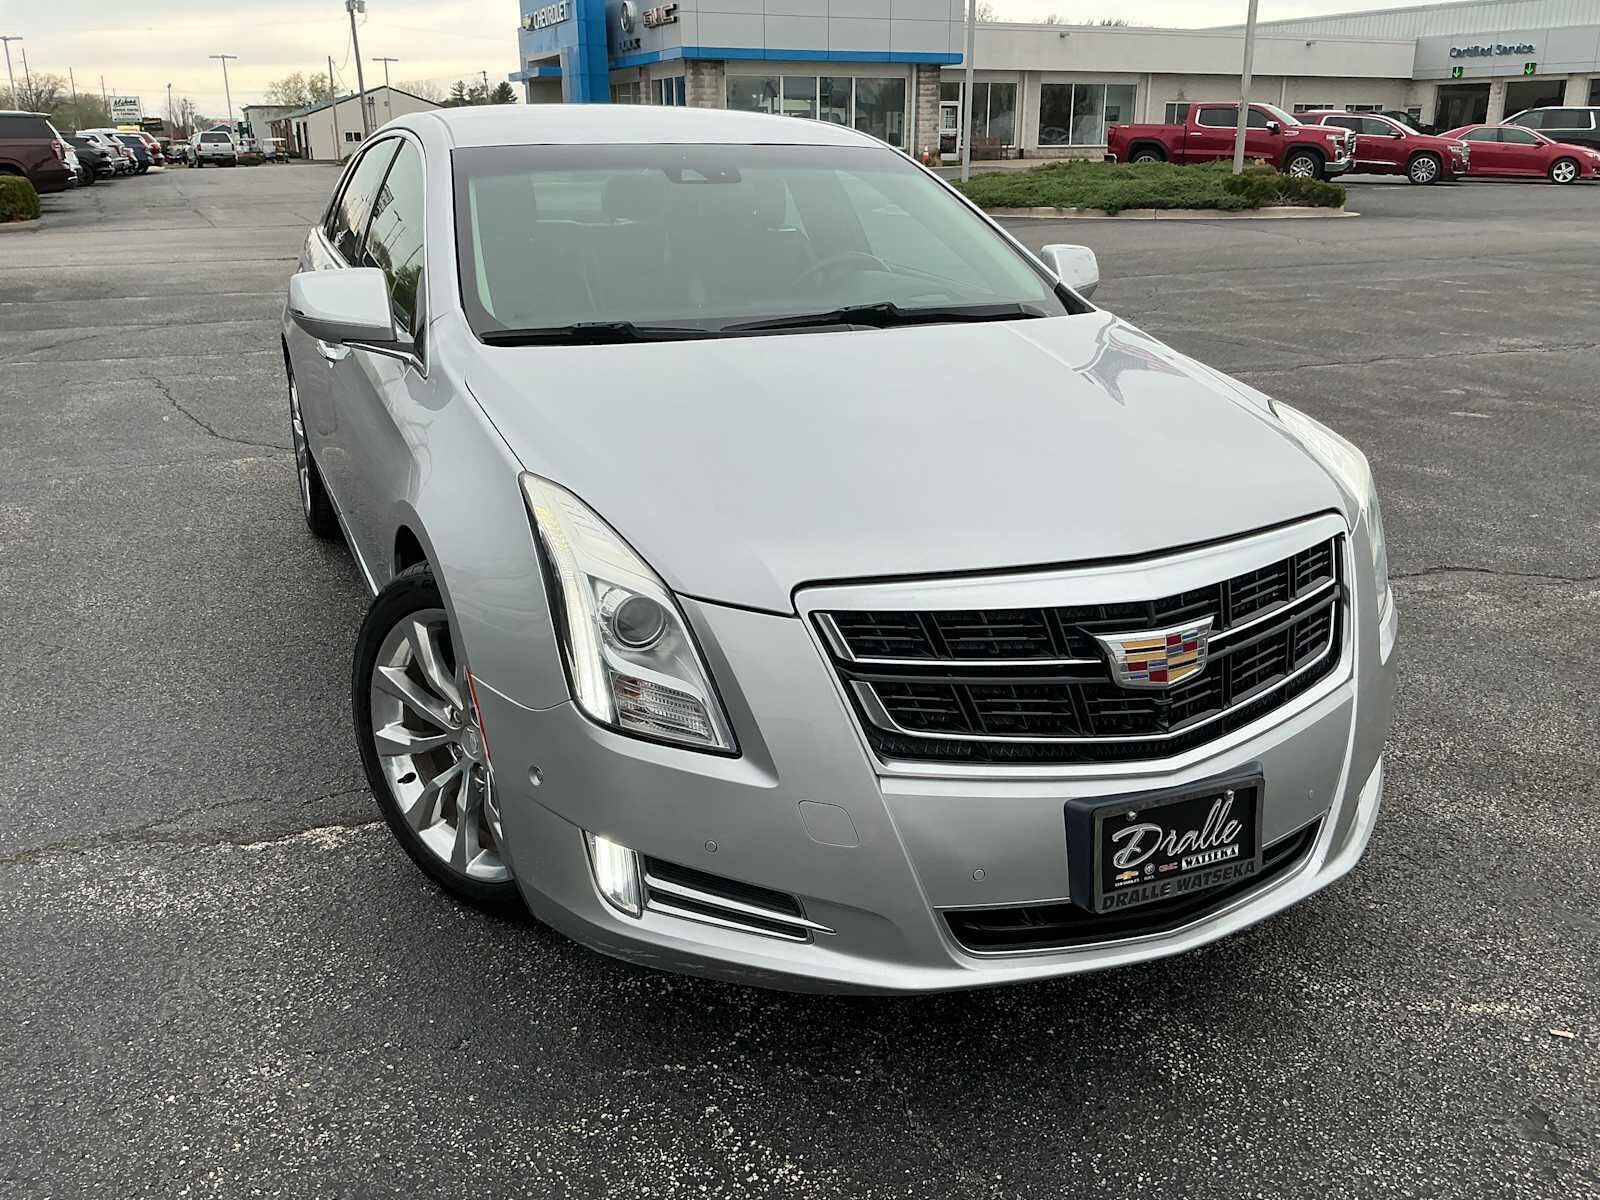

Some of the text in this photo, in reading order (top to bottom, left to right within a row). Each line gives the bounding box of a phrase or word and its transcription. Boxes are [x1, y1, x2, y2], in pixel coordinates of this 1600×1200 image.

[534, 1, 570, 29] CHEVROLET
[643, 4, 675, 27] GMC
[1450, 43, 1535, 58] Certified Service
[1112, 798, 1242, 869] Dralle
[1183, 845, 1238, 869] WATSEKA
[1102, 861, 1255, 911] DRALLE WATSEKA
